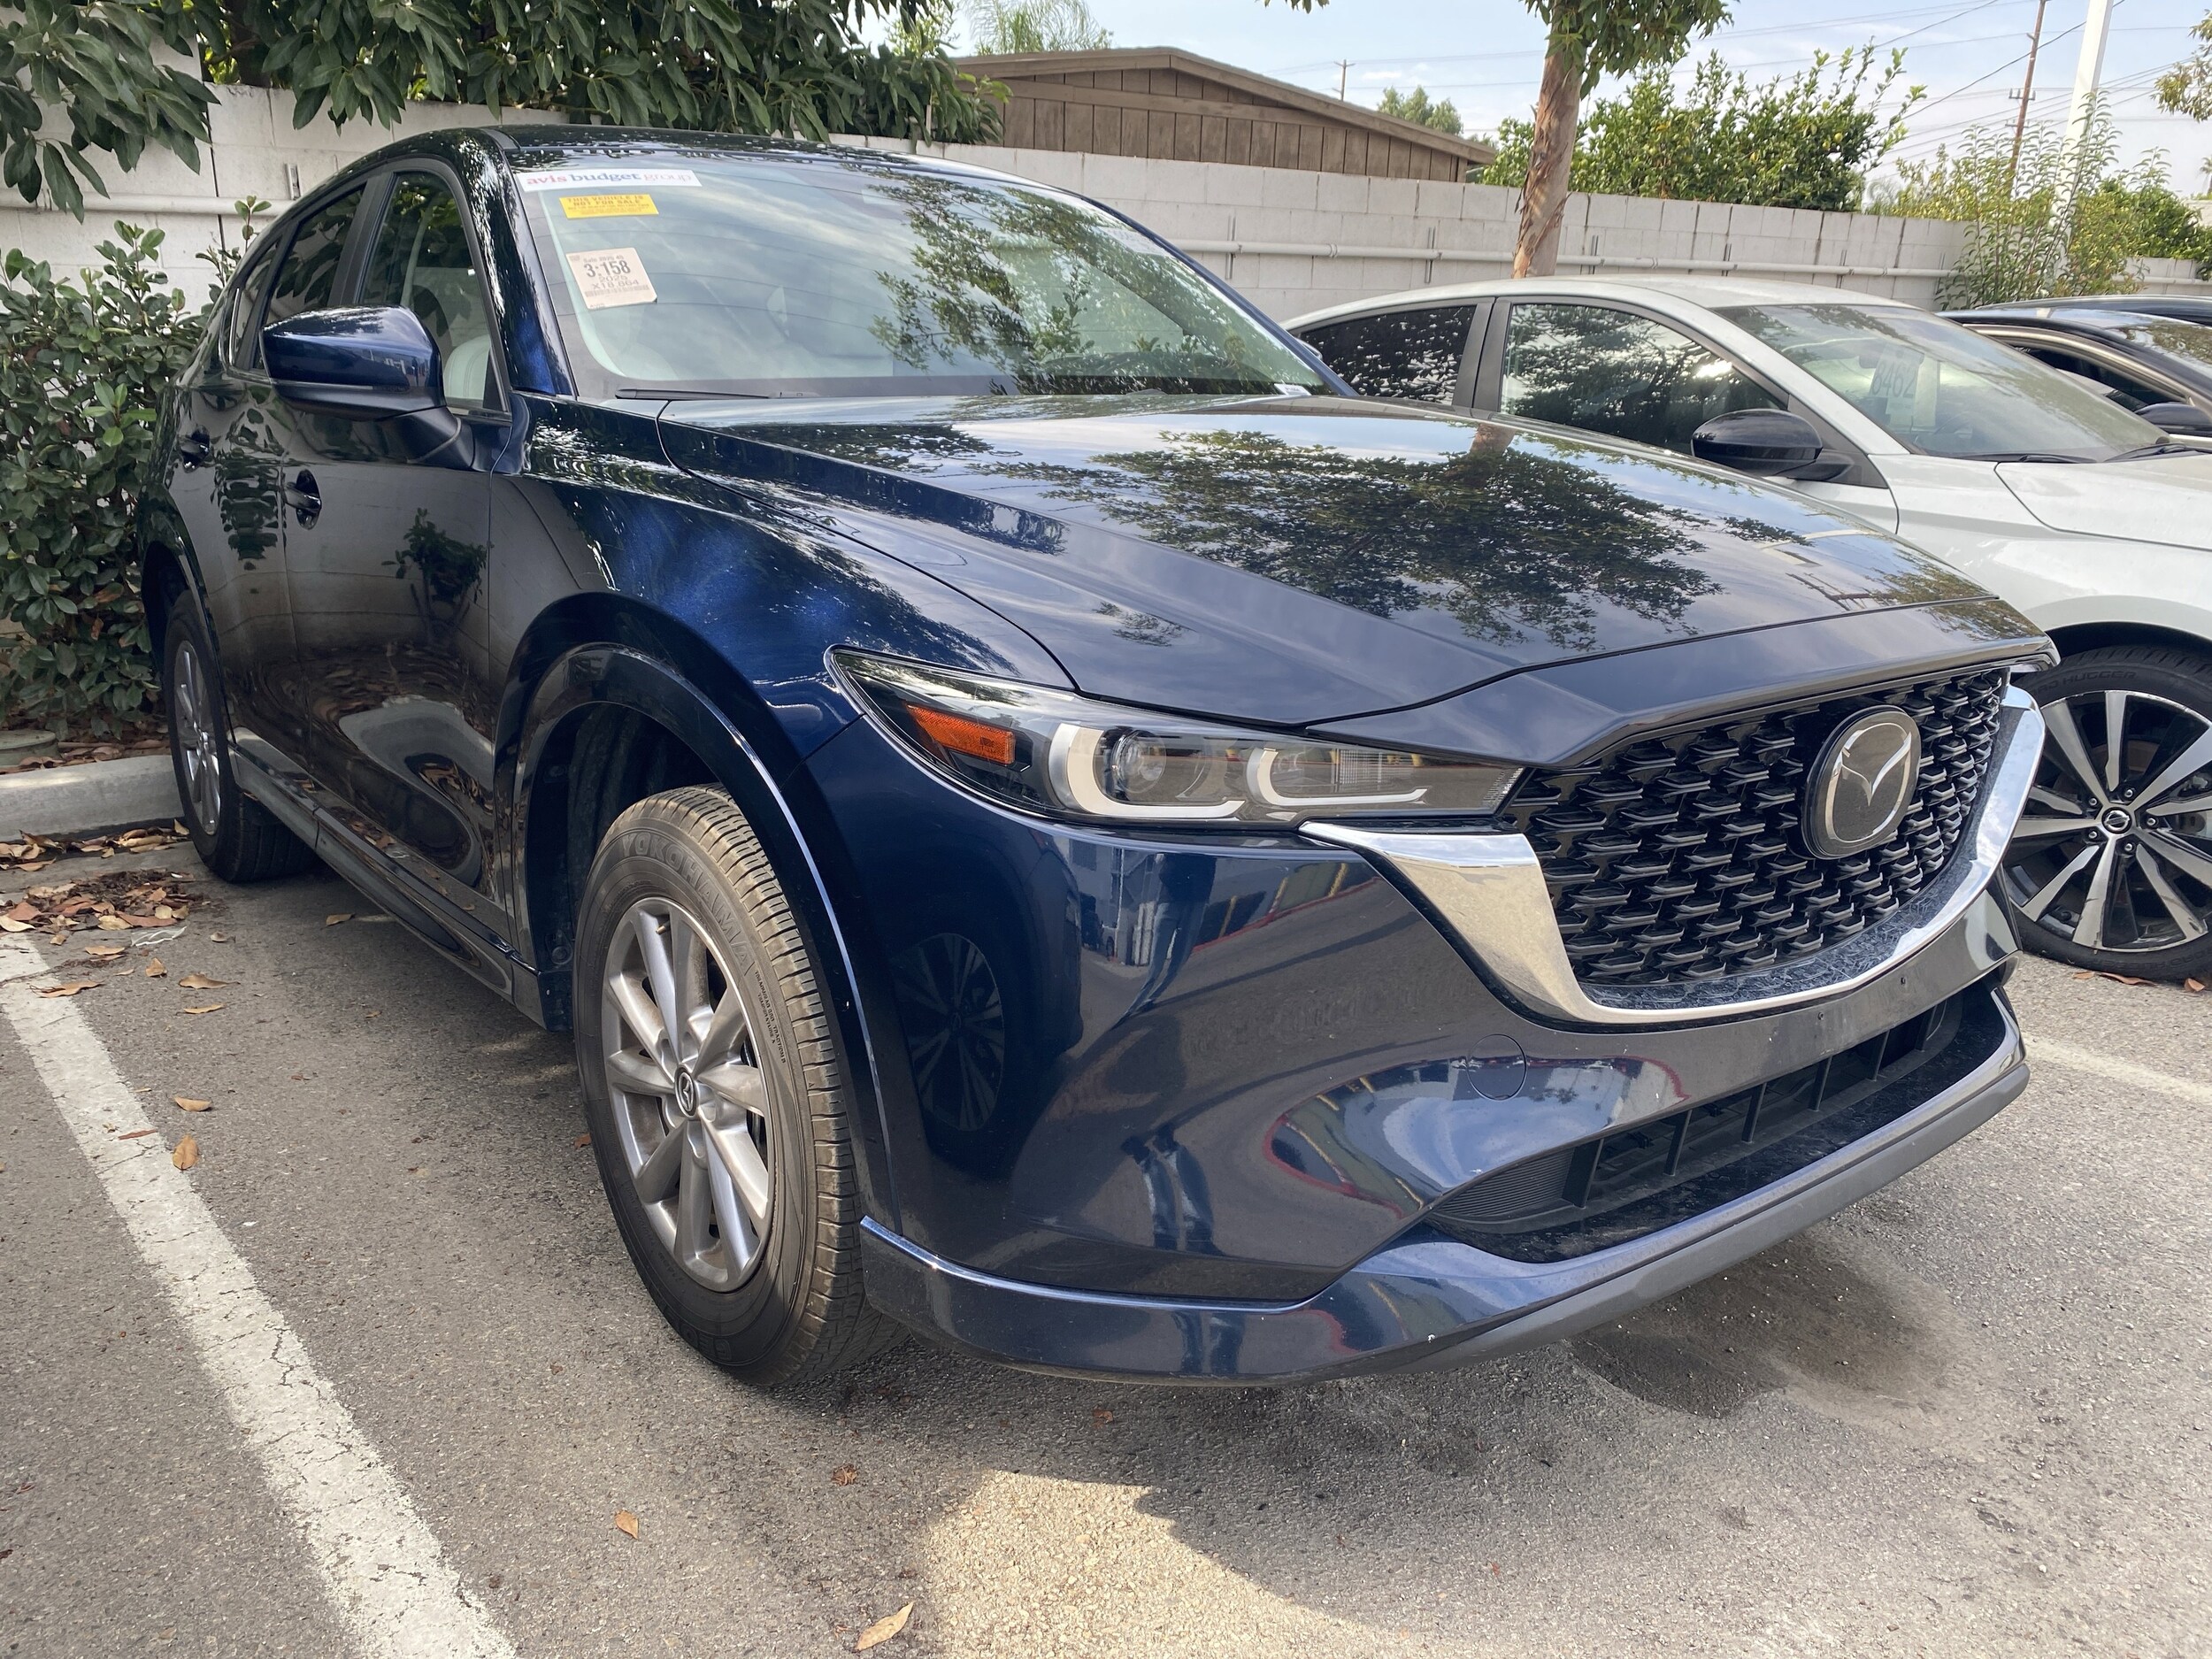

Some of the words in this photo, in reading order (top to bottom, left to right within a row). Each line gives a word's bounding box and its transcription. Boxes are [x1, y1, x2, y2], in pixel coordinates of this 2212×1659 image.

[526, 174, 567, 185] avis
[570, 173, 641, 182] budget
[643, 173, 692, 182] group
[584, 260, 631, 278] 3:158
[621, 832, 756, 976] YOKOHAMA
